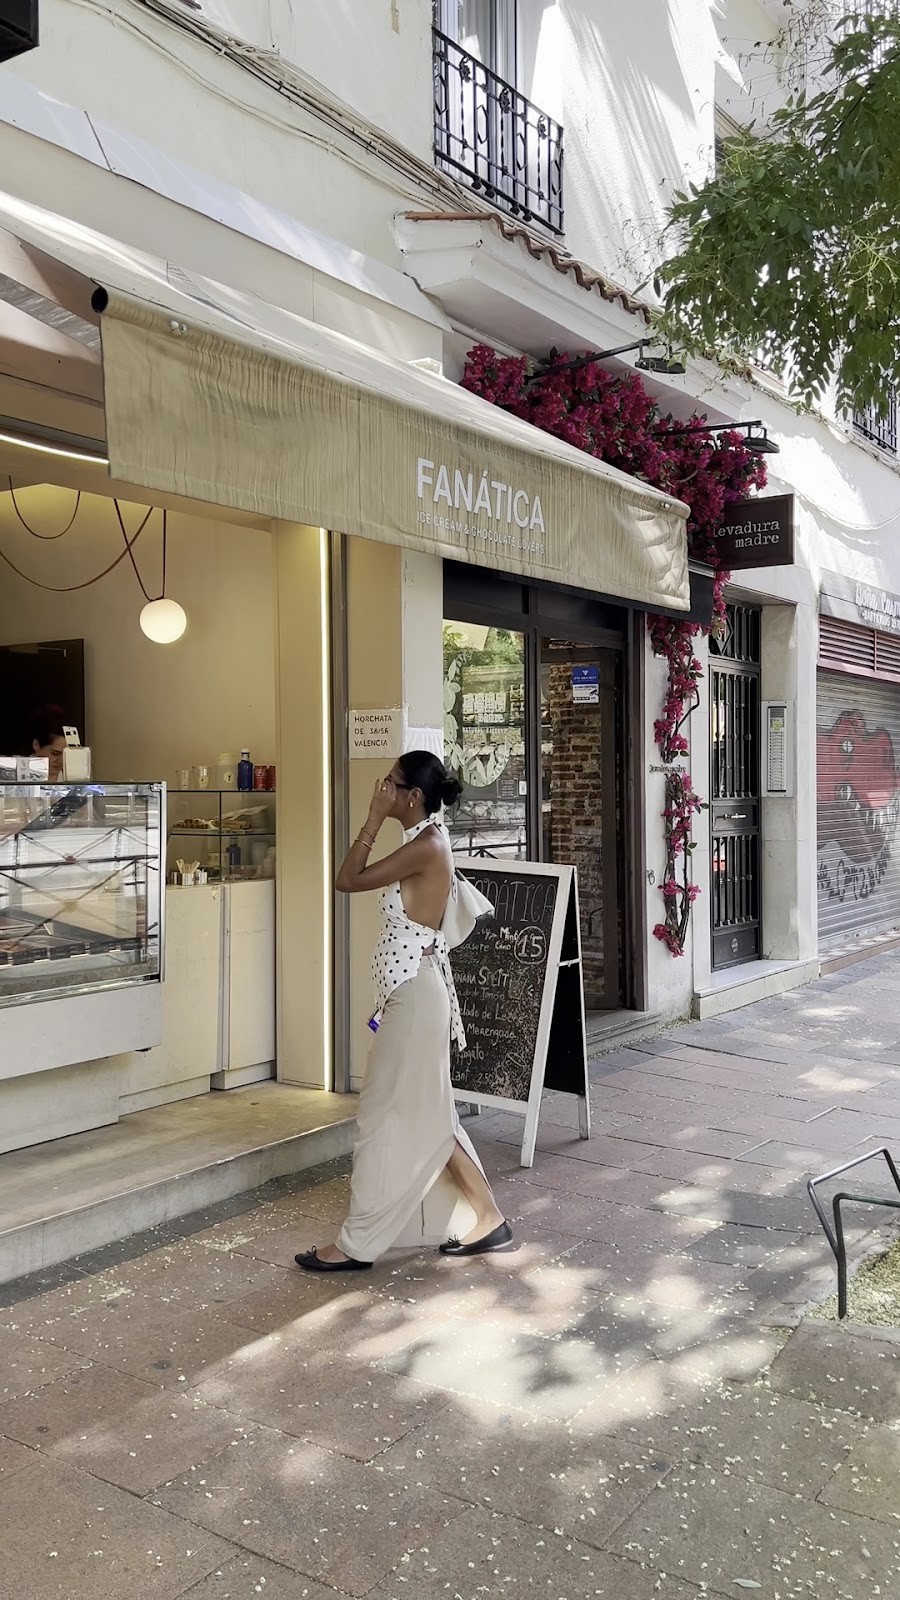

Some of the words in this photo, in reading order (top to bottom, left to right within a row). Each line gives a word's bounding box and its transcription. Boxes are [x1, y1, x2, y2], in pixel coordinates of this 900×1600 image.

[417, 457, 546, 533] FANÁTICA
[417, 511, 431, 525] ICE
[433, 515, 462, 534] CREAM
[735, 534, 780, 549] madre
[354, 715, 392, 723] HORCHATA
[465, 876, 557, 924] NÁTICA
